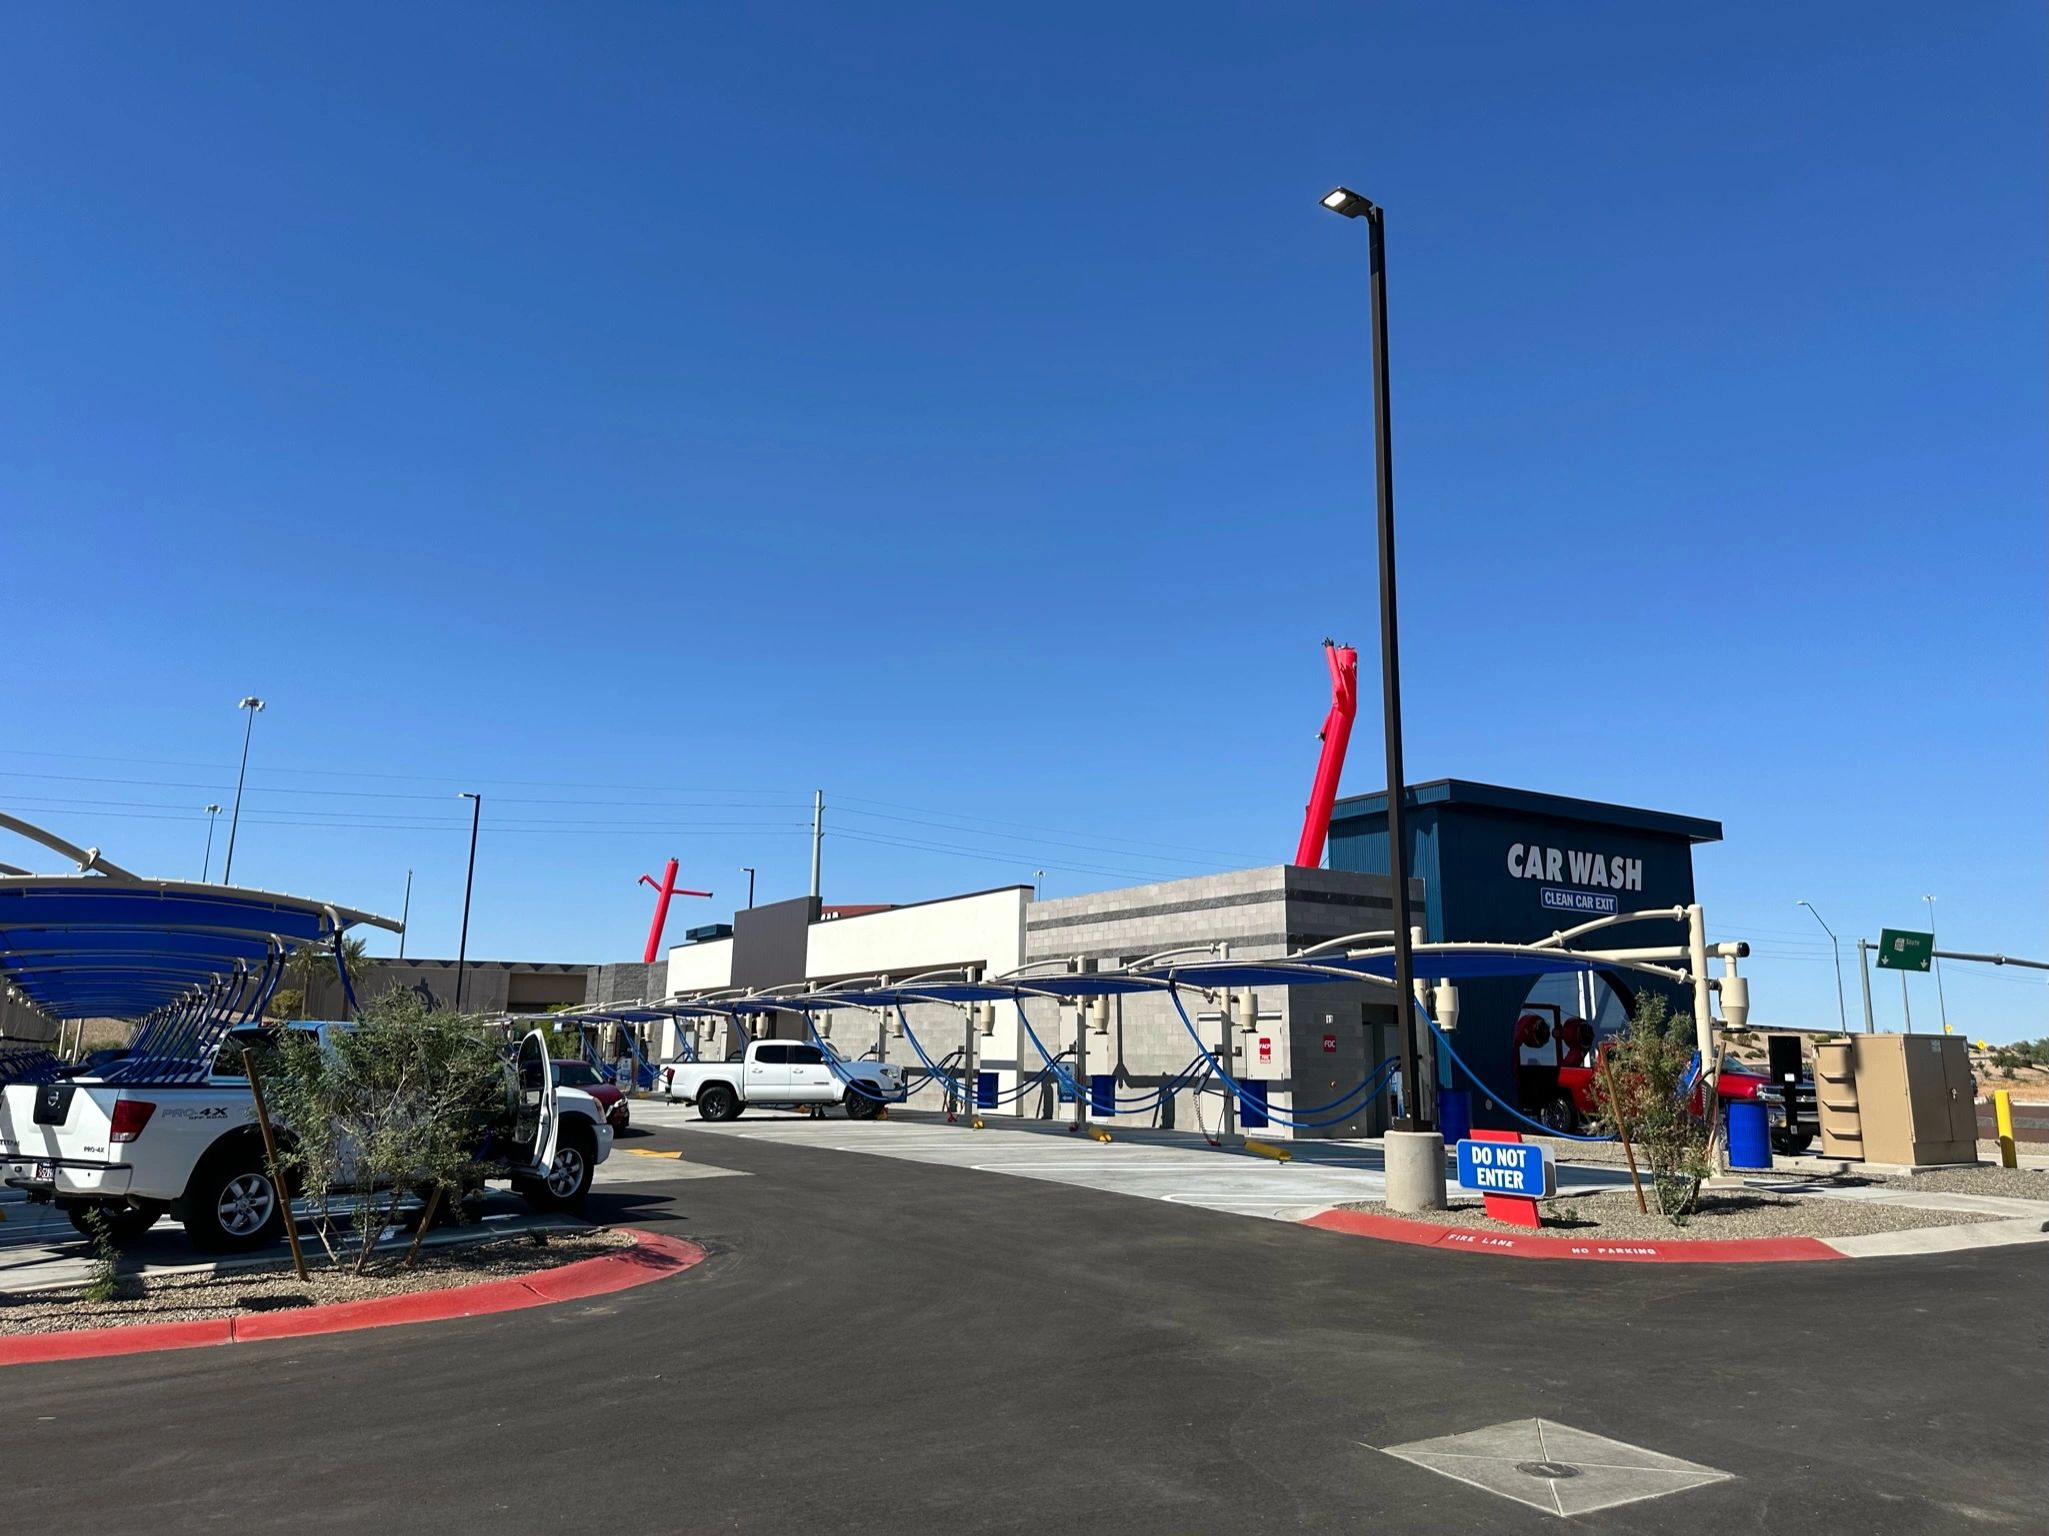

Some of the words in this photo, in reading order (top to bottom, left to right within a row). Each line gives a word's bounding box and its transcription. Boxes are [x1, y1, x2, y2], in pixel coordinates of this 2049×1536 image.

[1506, 843, 1563, 882] CAR
[1567, 850, 1643, 891] WASH
[1544, 891, 1574, 908] CLEAN
[1575, 895, 1594, 909] CAR
[1595, 897, 1615, 911] EXIT
[161, 1107, 229, 1118] PRO-4X
[83, 1145, 105, 1153] PRO-4X
[1471, 1146, 1493, 1166] DO
[1496, 1147, 1527, 1168] NOT
[1476, 1167, 1524, 1190] ENTER
[1447, 1233, 1477, 1243] FIRE
[1481, 1237, 1516, 1248] LANE
[1597, 1247, 1657, 1255] PARKING
